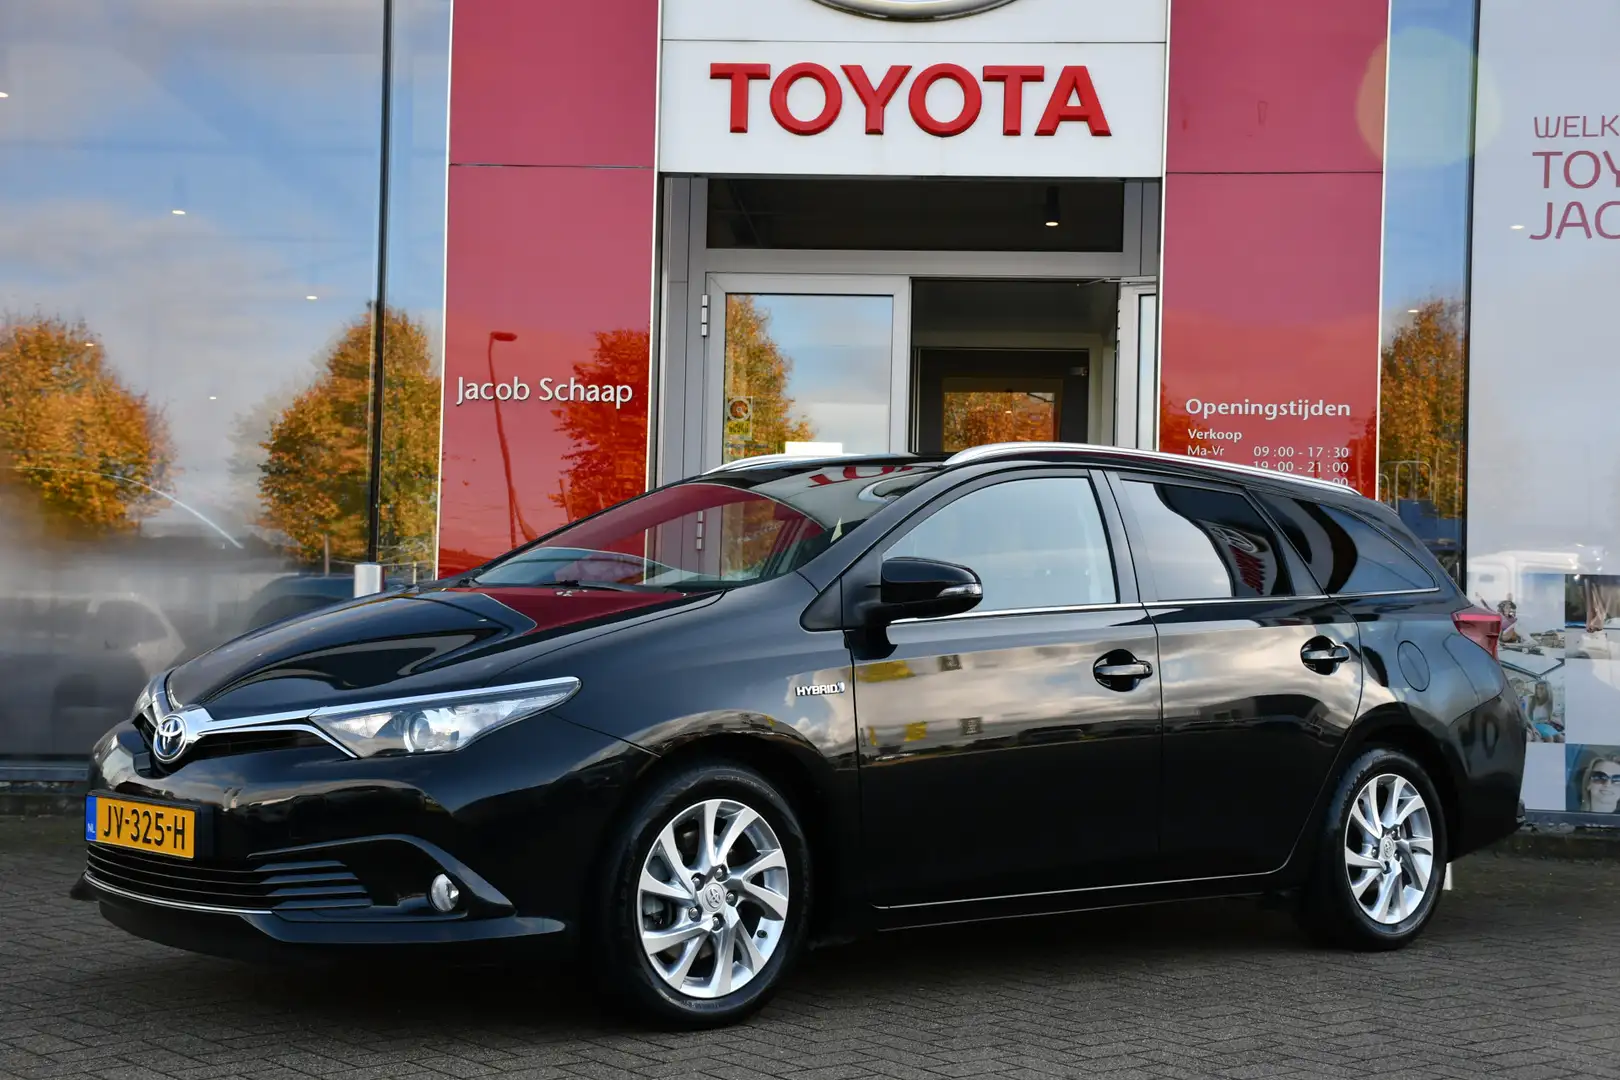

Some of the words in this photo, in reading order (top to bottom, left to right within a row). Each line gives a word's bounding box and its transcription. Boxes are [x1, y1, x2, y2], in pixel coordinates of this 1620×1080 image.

[710, 62, 1112, 137] TOYOTA
[1533, 114, 1620, 138] WELK
[1529, 200, 1620, 240] JAC
[456, 376, 530, 406] Jacob
[539, 377, 633, 409] Schaap
[1185, 398, 1351, 421] Openingstijden
[1187, 428, 1243, 443] Verkoop
[1187, 445, 1225, 456] Ma-Vr
[796, 683, 840, 696] HYBRID
[87, 822, 96, 834] NL
[103, 805, 186, 850] JV-325-H
